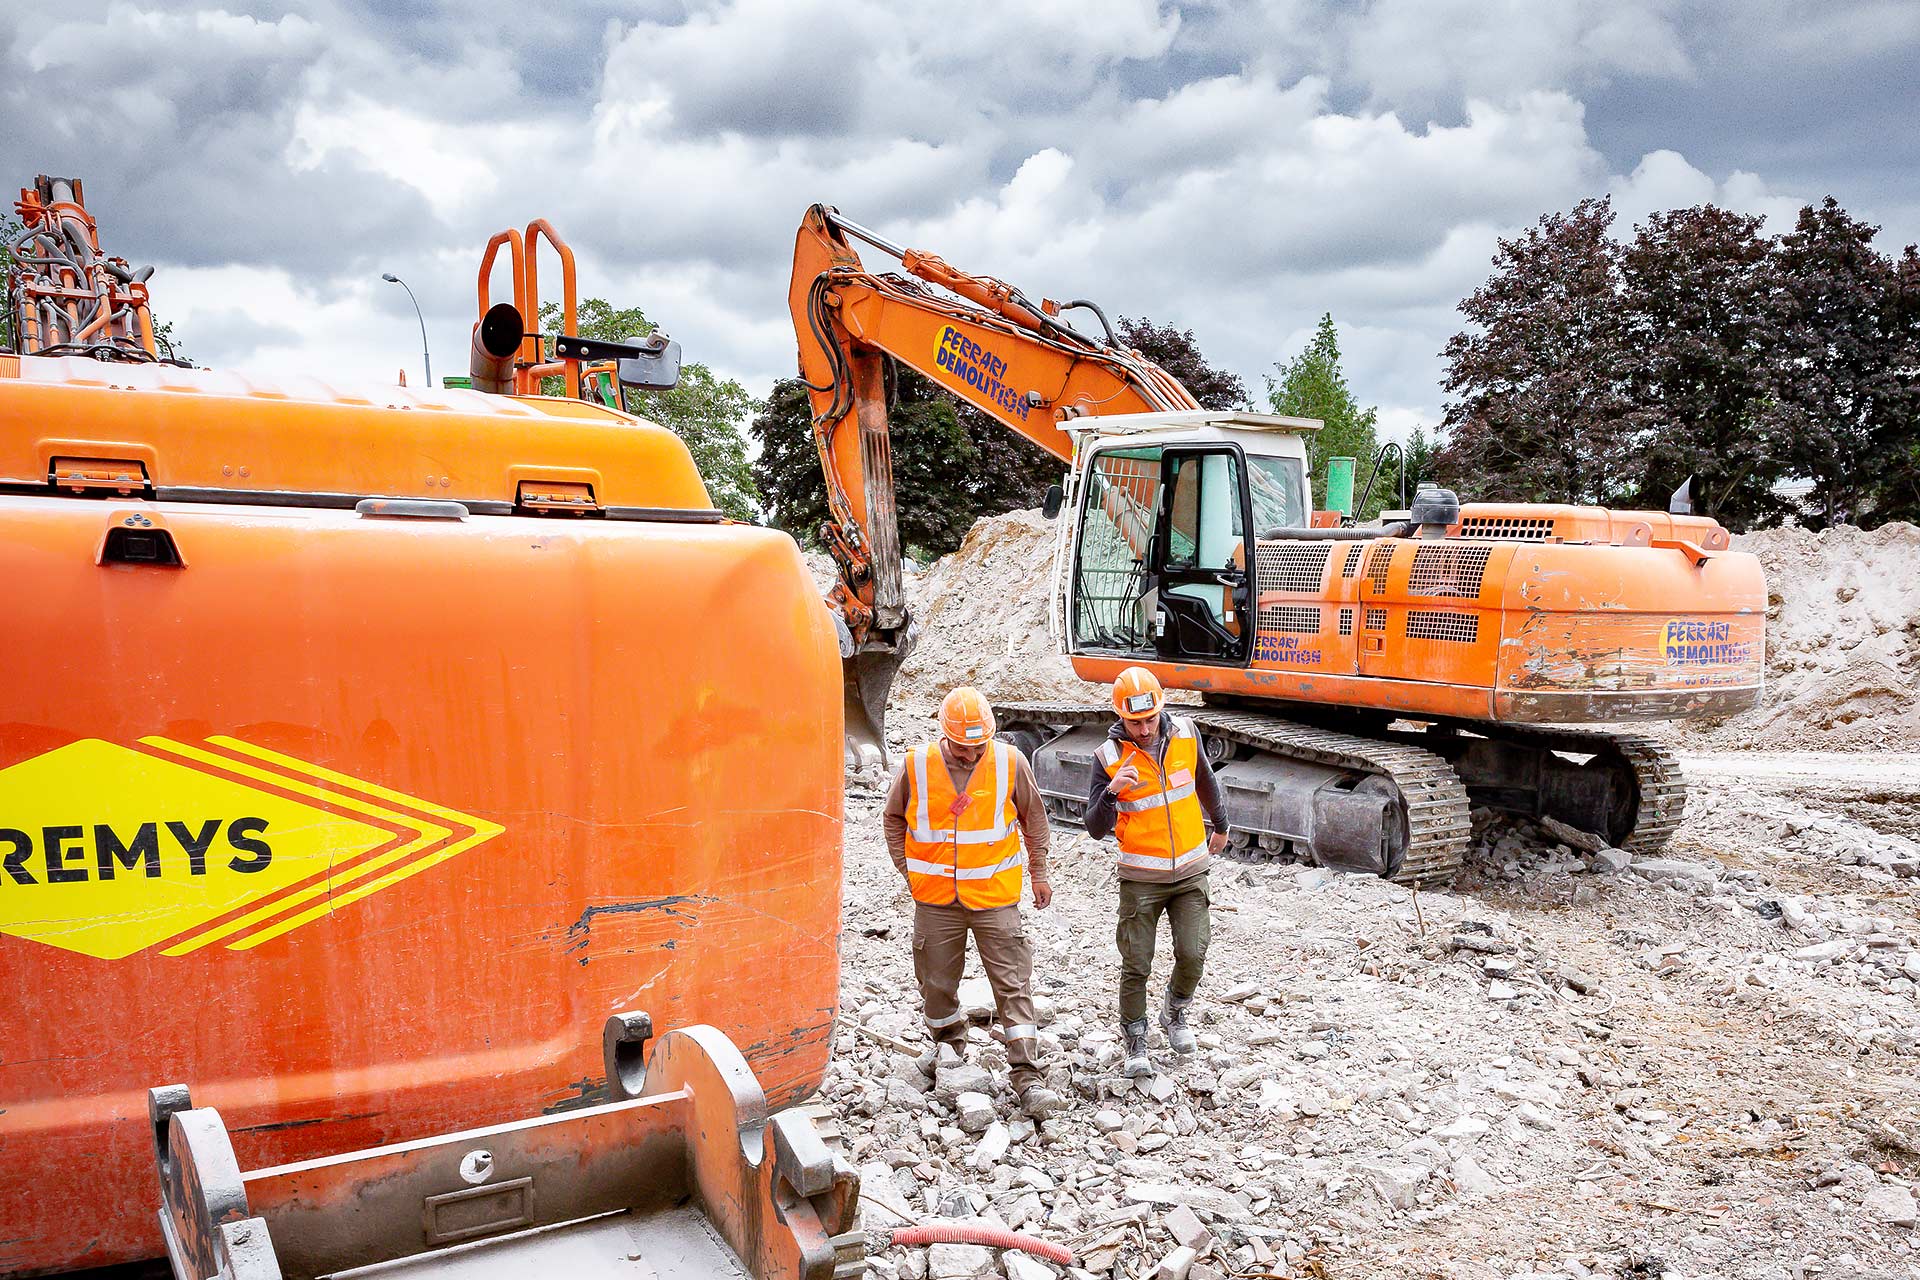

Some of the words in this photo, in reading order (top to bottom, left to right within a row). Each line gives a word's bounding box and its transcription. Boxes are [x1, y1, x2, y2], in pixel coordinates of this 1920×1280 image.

[942, 326, 1008, 380] FERRARI
[936, 346, 1030, 422] DEMOLITION
[1255, 635, 1299, 649] ERRARI
[1666, 621, 1730, 643] FERRARI
[1253, 649, 1321, 665] EMOLITION
[0, 816, 273, 886] REMYS
